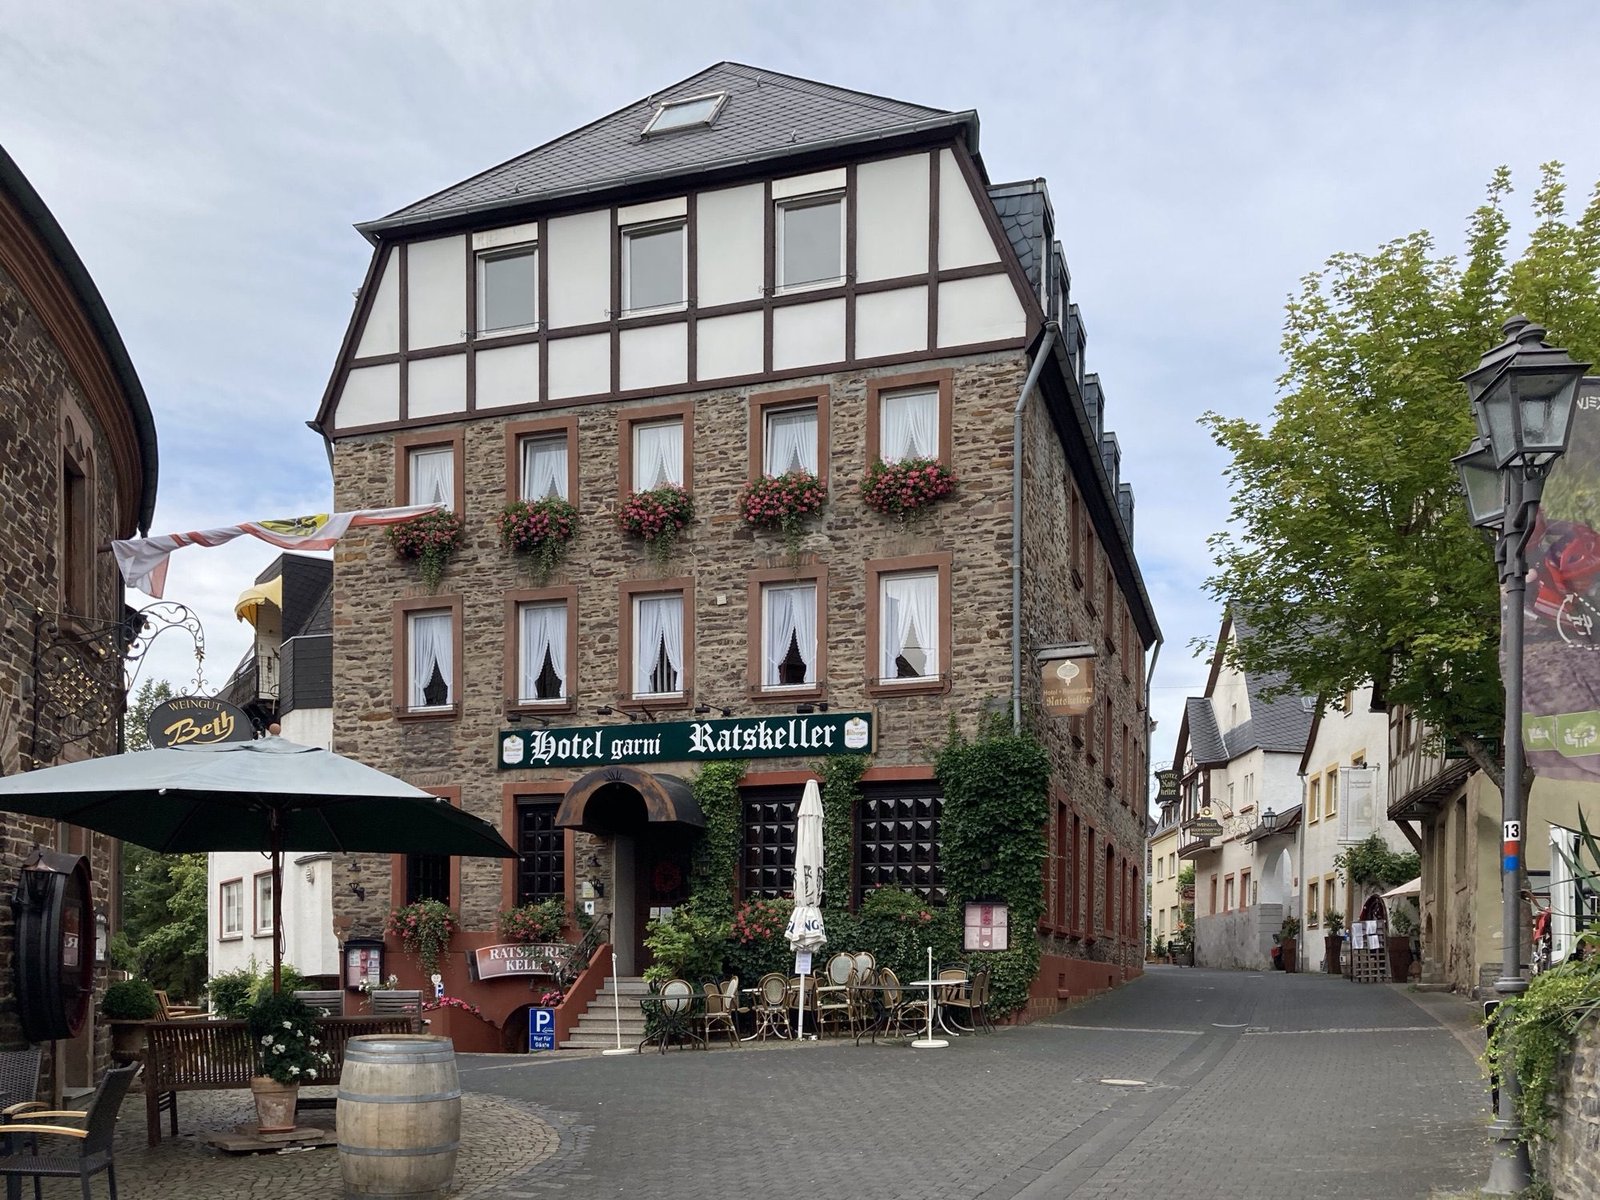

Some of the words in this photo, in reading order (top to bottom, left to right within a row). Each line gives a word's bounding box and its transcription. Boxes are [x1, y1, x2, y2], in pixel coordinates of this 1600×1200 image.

[168, 699, 222, 712] WEINGUT
[164, 710, 235, 747] Beth
[529, 728, 604, 766] Hotel
[610, 733, 662, 761] garni
[687, 717, 837, 754] Ratskeller
[1504, 823, 1519, 838] 13
[536, 1010, 551, 1033] P
